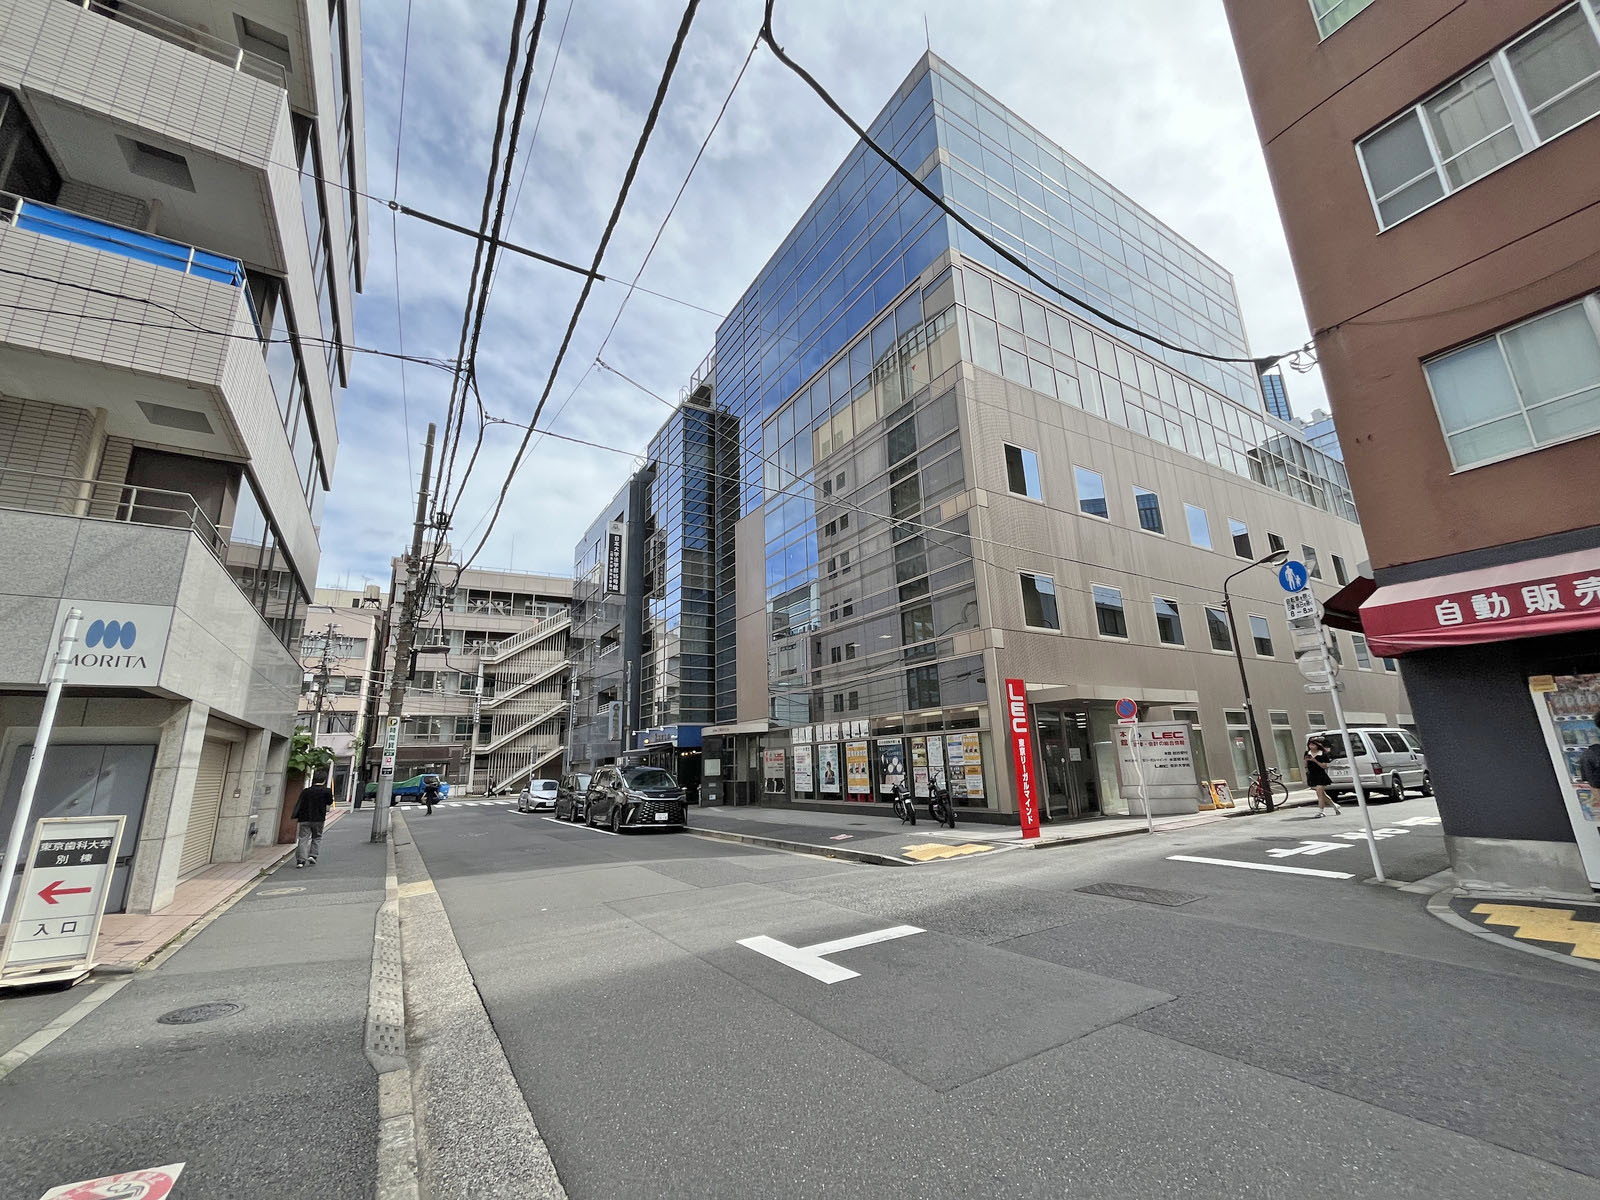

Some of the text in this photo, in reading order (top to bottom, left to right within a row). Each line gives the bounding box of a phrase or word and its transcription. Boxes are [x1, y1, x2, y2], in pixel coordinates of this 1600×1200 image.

[1435, 576, 1600, 626] 自動販売
[1151, 731, 1184, 739] LEC
[1008, 683, 1033, 825] LEC 東京リーガルマインド
[40, 840, 111, 852] 東京歯科大学
[33, 921, 77, 936] 入口
